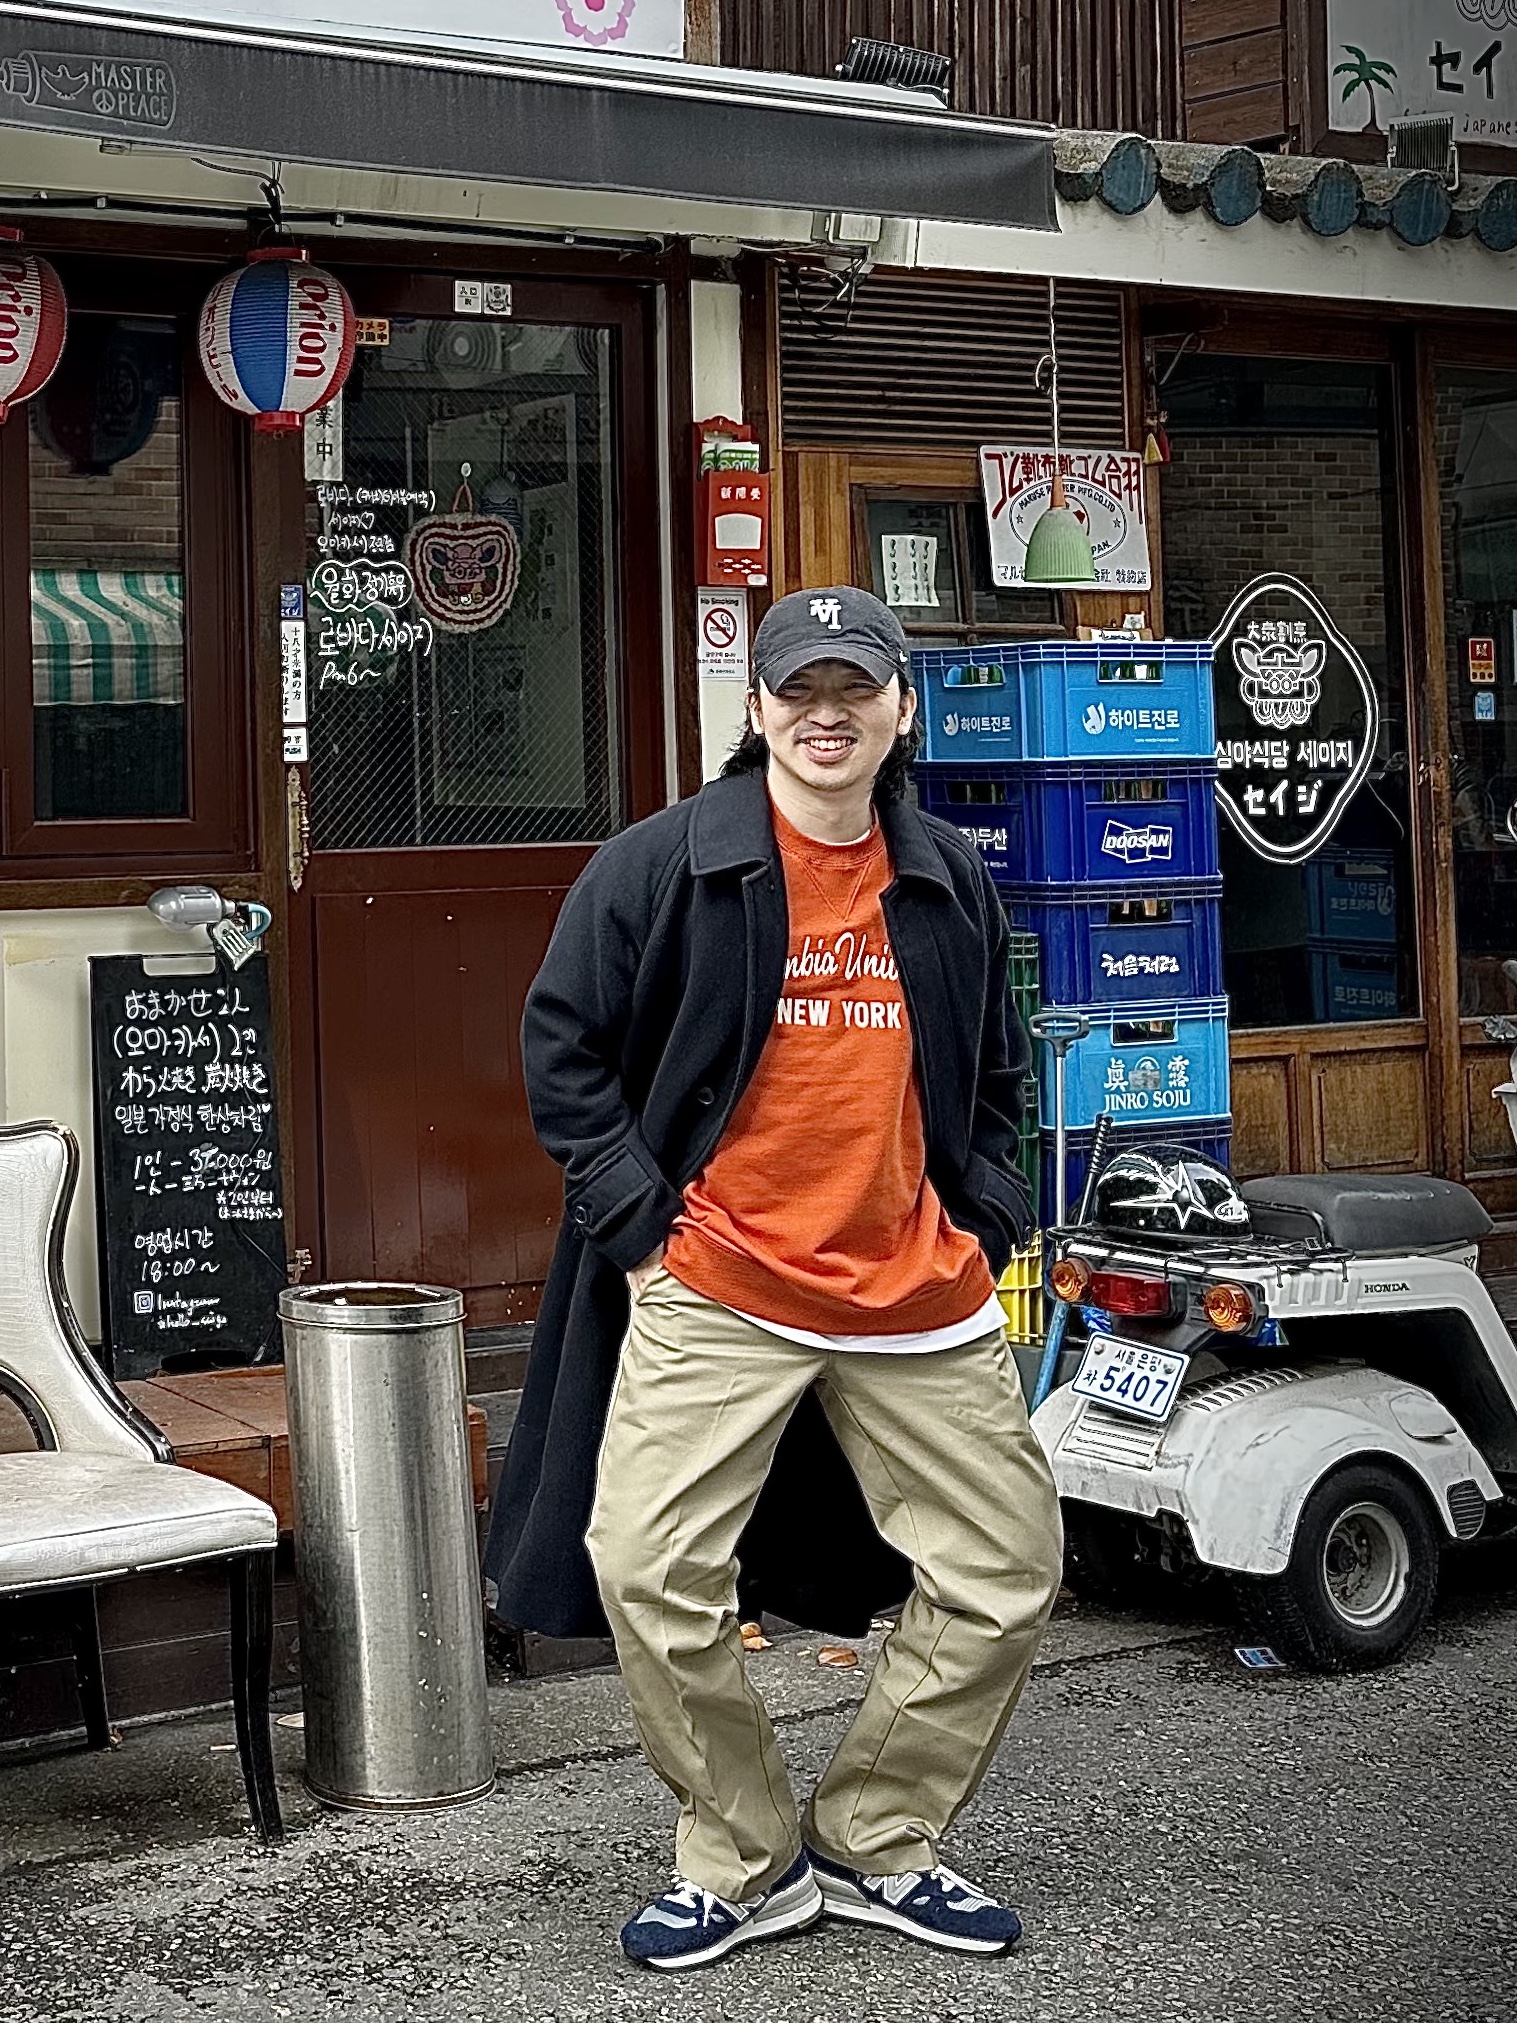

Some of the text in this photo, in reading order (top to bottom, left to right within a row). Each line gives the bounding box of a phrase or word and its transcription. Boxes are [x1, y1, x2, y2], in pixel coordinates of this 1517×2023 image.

[92, 61, 167, 93] MASTER
[118, 92, 169, 120] PEACE
[1247, 621, 1307, 643] 大衆割烹
[961, 716, 1012, 733] 하이트진로
[1108, 708, 1180, 730] 하이트진로
[1215, 740, 1353, 769] 심야식당 세이지
[1243, 779, 1322, 816] セイジ
[1105, 833, 1170, 849] DOOSAN
[1101, 953, 1180, 977] 처음처럼
[125, 989, 213, 1020] おまかせ
[777, 997, 902, 1029] NEW YORK
[1104, 1088, 1191, 1113] JINRO SOJU
[115, 1104, 149, 1134] 일본
[148, 1104, 194, 1134] 가정식
[134, 1226, 214, 1256] 영업시간
[1364, 1282, 1410, 1293] HONDA
[1099, 1365, 1169, 1407] 5407
